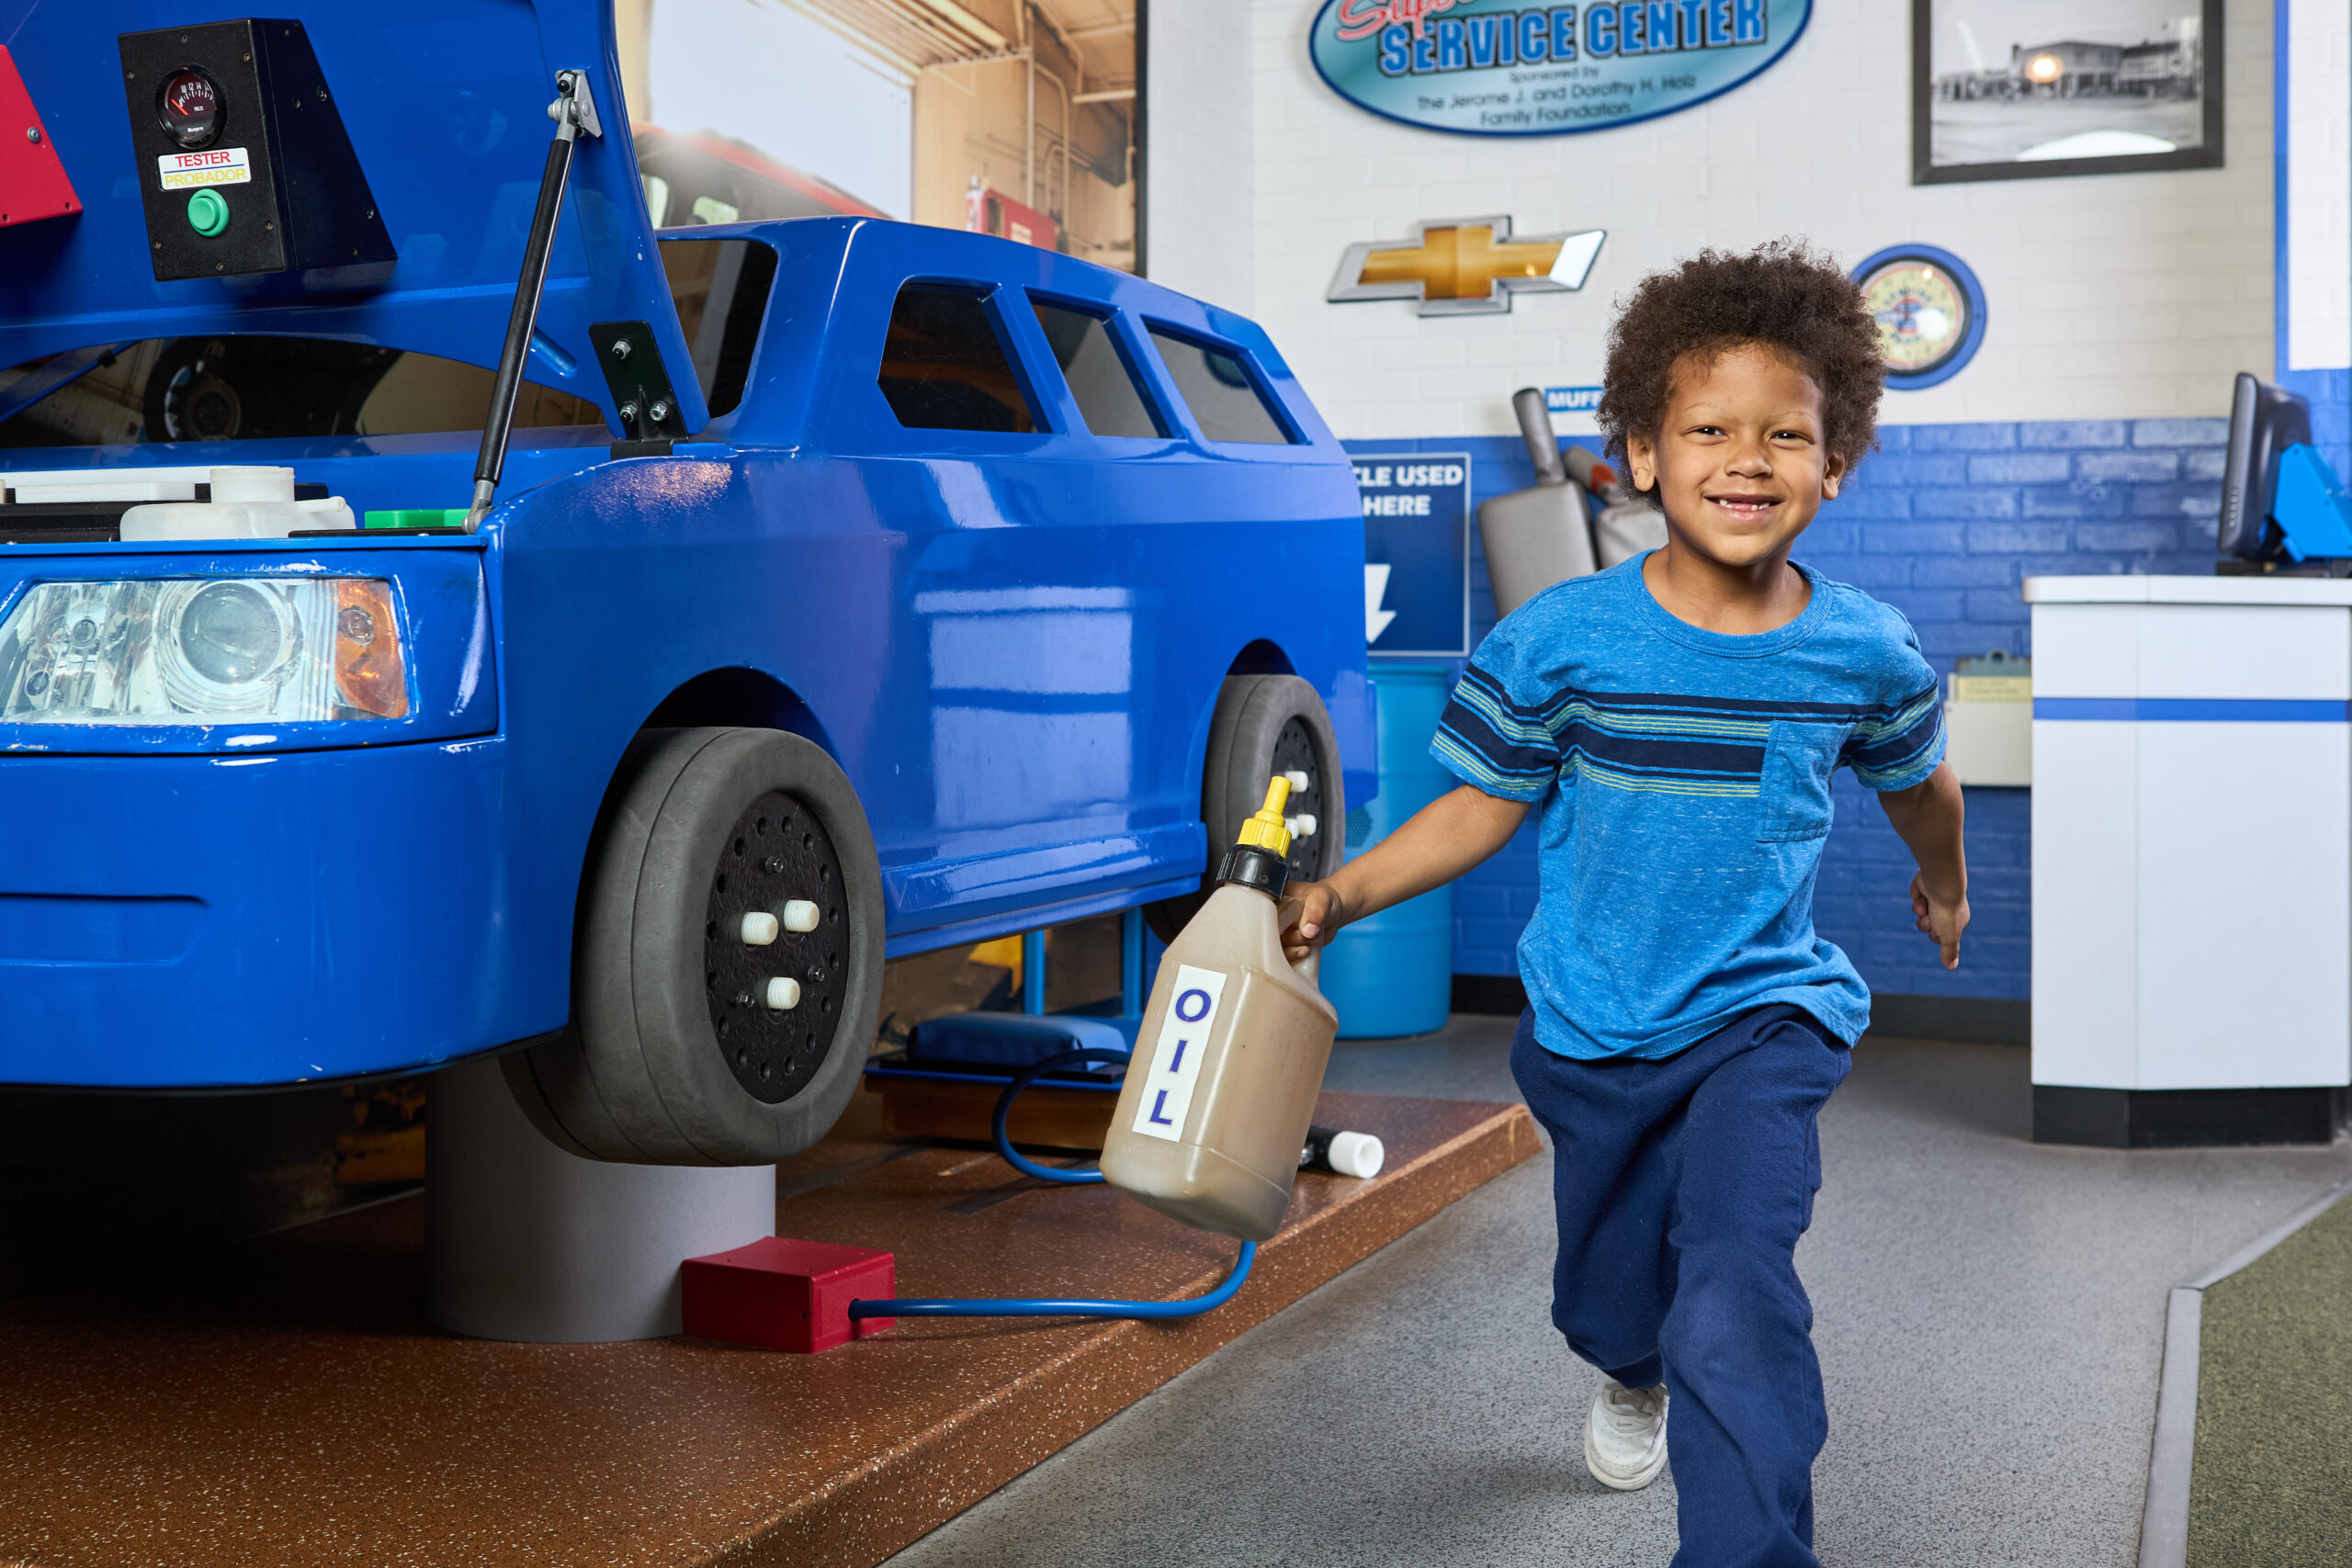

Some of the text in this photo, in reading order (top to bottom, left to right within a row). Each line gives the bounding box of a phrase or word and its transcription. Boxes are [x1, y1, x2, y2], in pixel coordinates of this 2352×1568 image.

[1380, 0, 1766, 77] SERVICE CENTER
[1510, 64, 1600, 84] Sponsored by
[181, 85, 187, 93] 10
[188, 82, 194, 91] 12
[195, 82, 201, 90] 14
[1418, 95, 1445, 109] The
[1449, 93, 1509, 108] Jerome
[1532, 85, 1566, 102] and
[1570, 79, 1635, 98] Dorothy
[1480, 103, 1632, 126] Family Foundation
[175, 151, 232, 168] TESTER
[164, 168, 247, 187] PROBADOR
[1396, 464, 1464, 487] USED
[1363, 494, 1431, 516] HERE
[1148, 987, 1212, 1126] OIL
